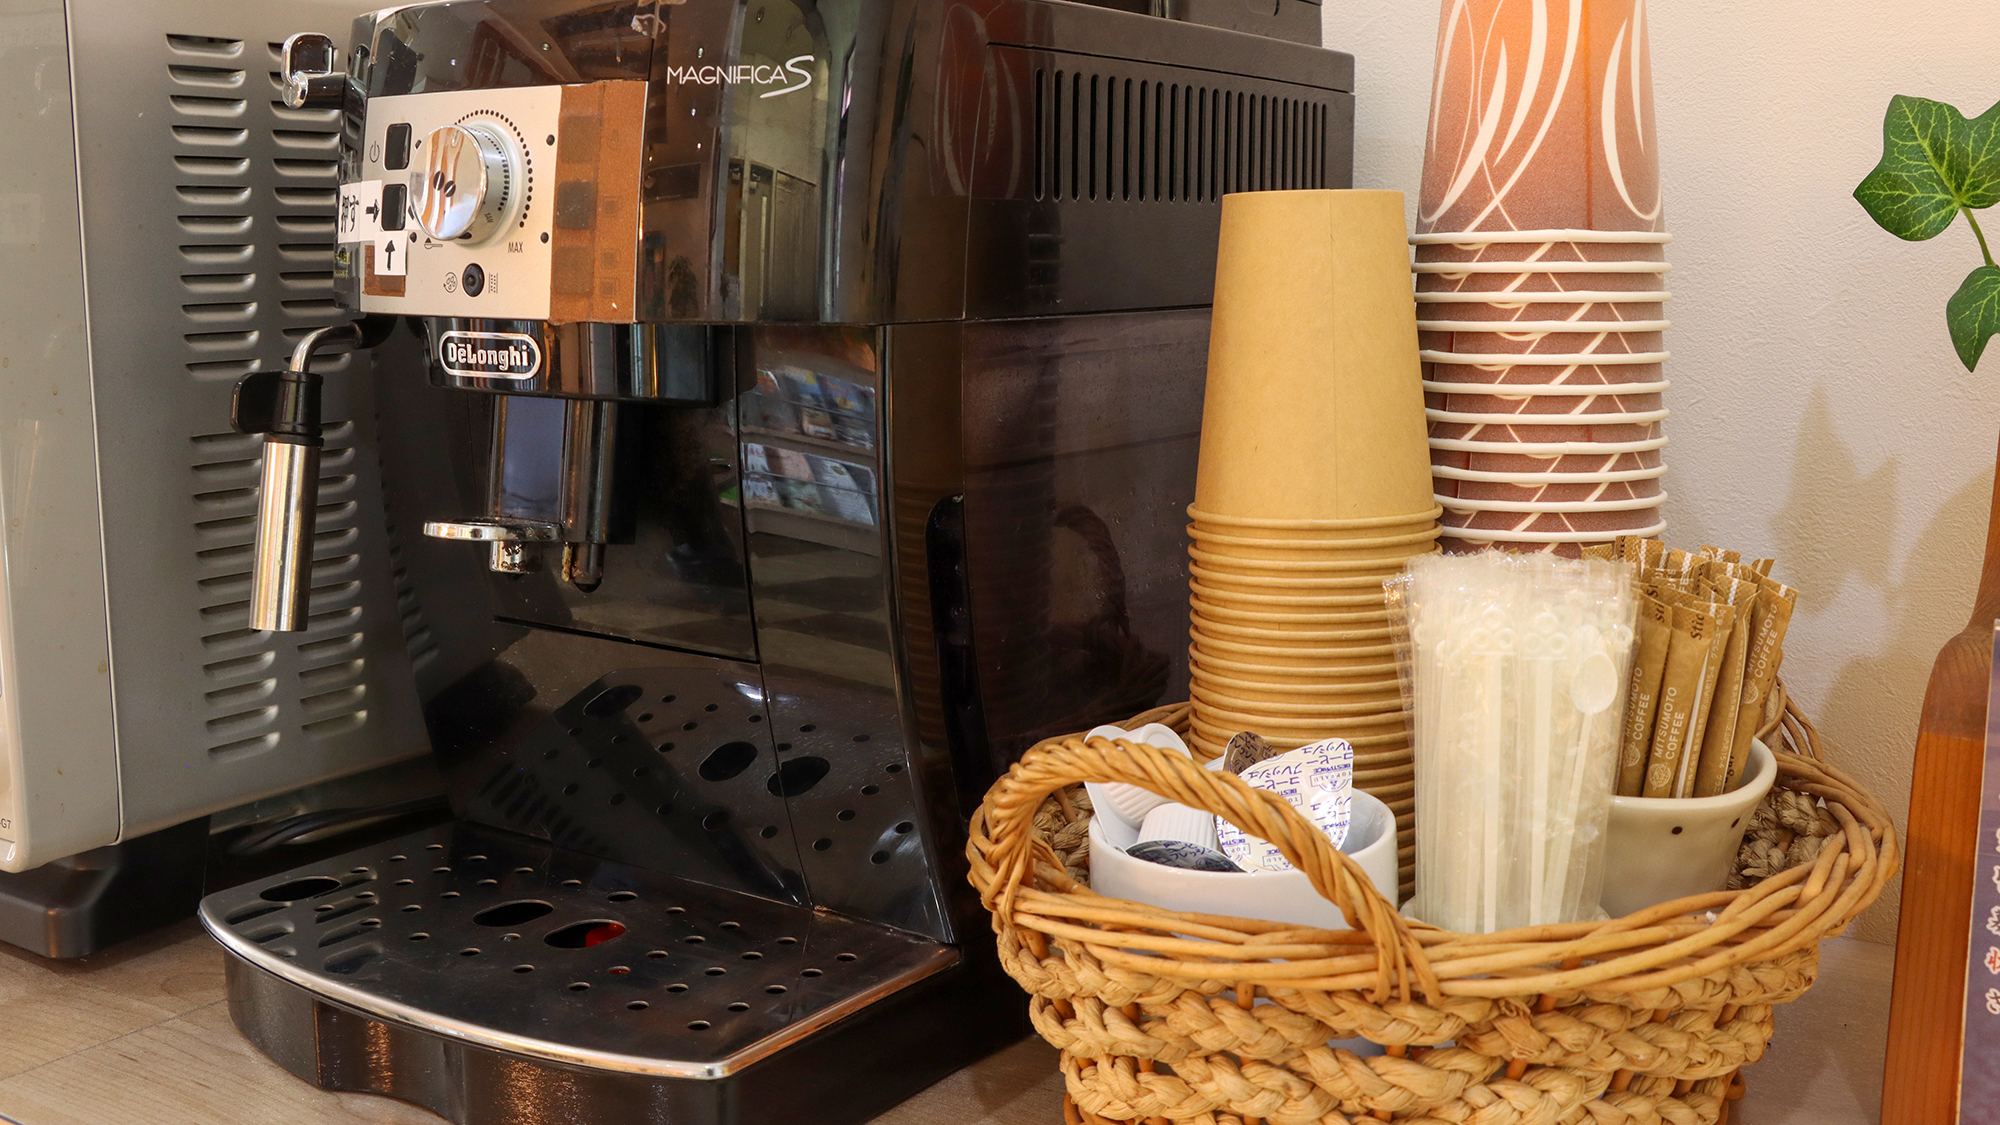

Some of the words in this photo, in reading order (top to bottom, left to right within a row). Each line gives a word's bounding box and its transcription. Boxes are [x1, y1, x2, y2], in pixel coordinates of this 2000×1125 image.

[666, 65, 788, 85] MAGNIFICA
[340, 194, 360, 234] 押す
[507, 241, 524, 254] MAX
[1745, 603, 1779, 674] MITSUMOTO
[1754, 628, 1779, 679] COFFEE
[1632, 692, 1650, 741] COFFEE
[1653, 686, 1678, 759] MITSUMOTO
[1665, 711, 1686, 760] COFFEE
[1247, 762, 1303, 780] フレッシュ
[1306, 752, 1353, 765] コーヒー
[1252, 776, 1300, 790] コーヒー
